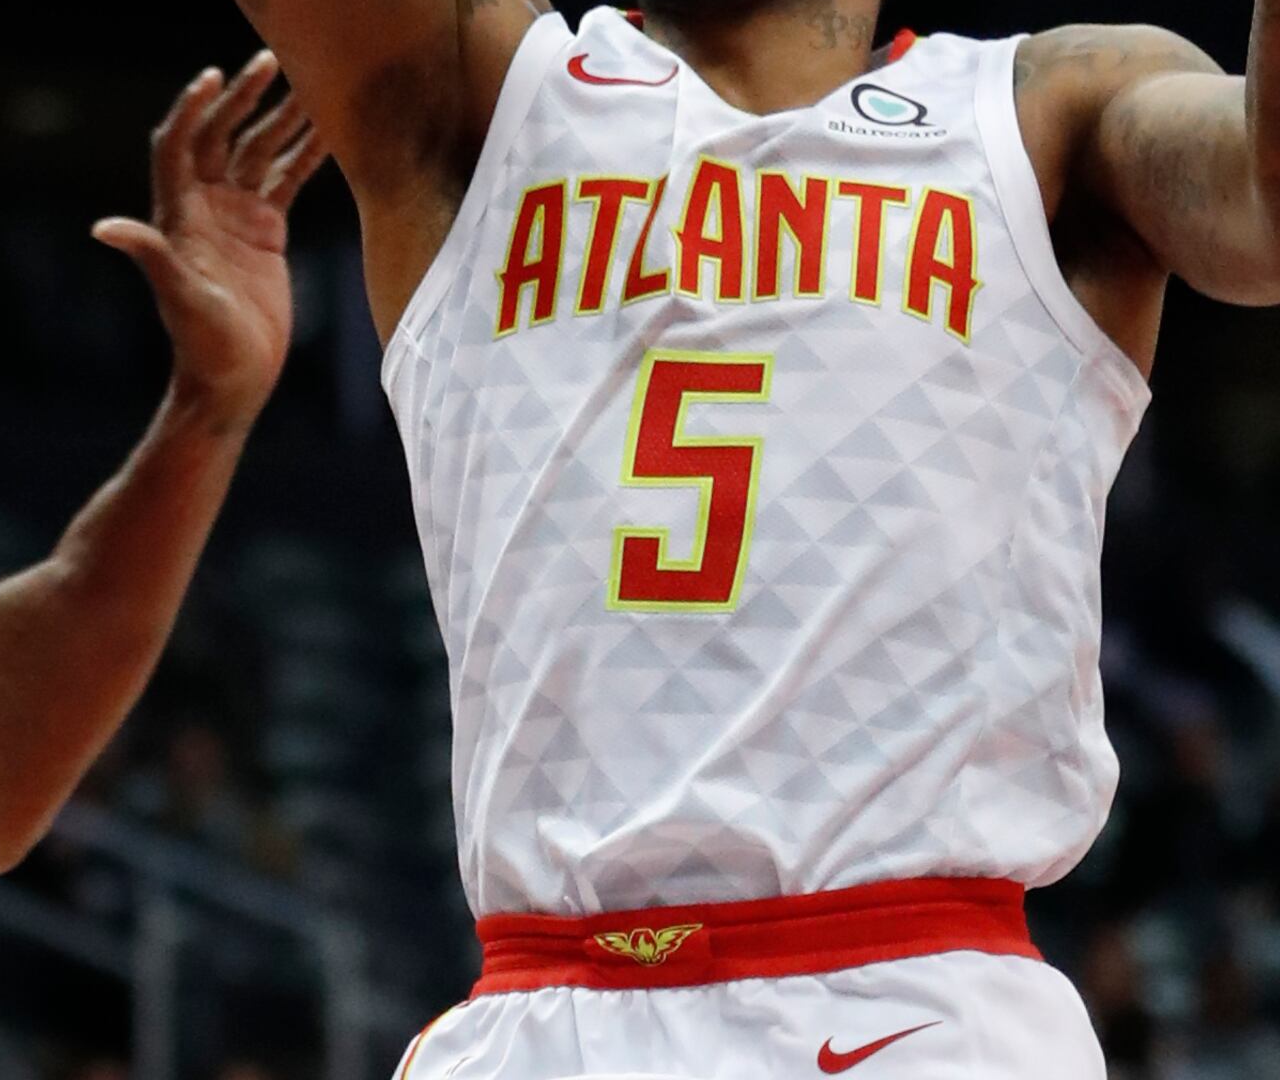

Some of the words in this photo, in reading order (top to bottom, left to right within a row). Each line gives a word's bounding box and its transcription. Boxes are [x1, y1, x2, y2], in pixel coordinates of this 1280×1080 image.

[827, 120, 949, 139] sharecare
[493, 154, 984, 346] ATLANTA
[605, 348, 776, 614] 5
